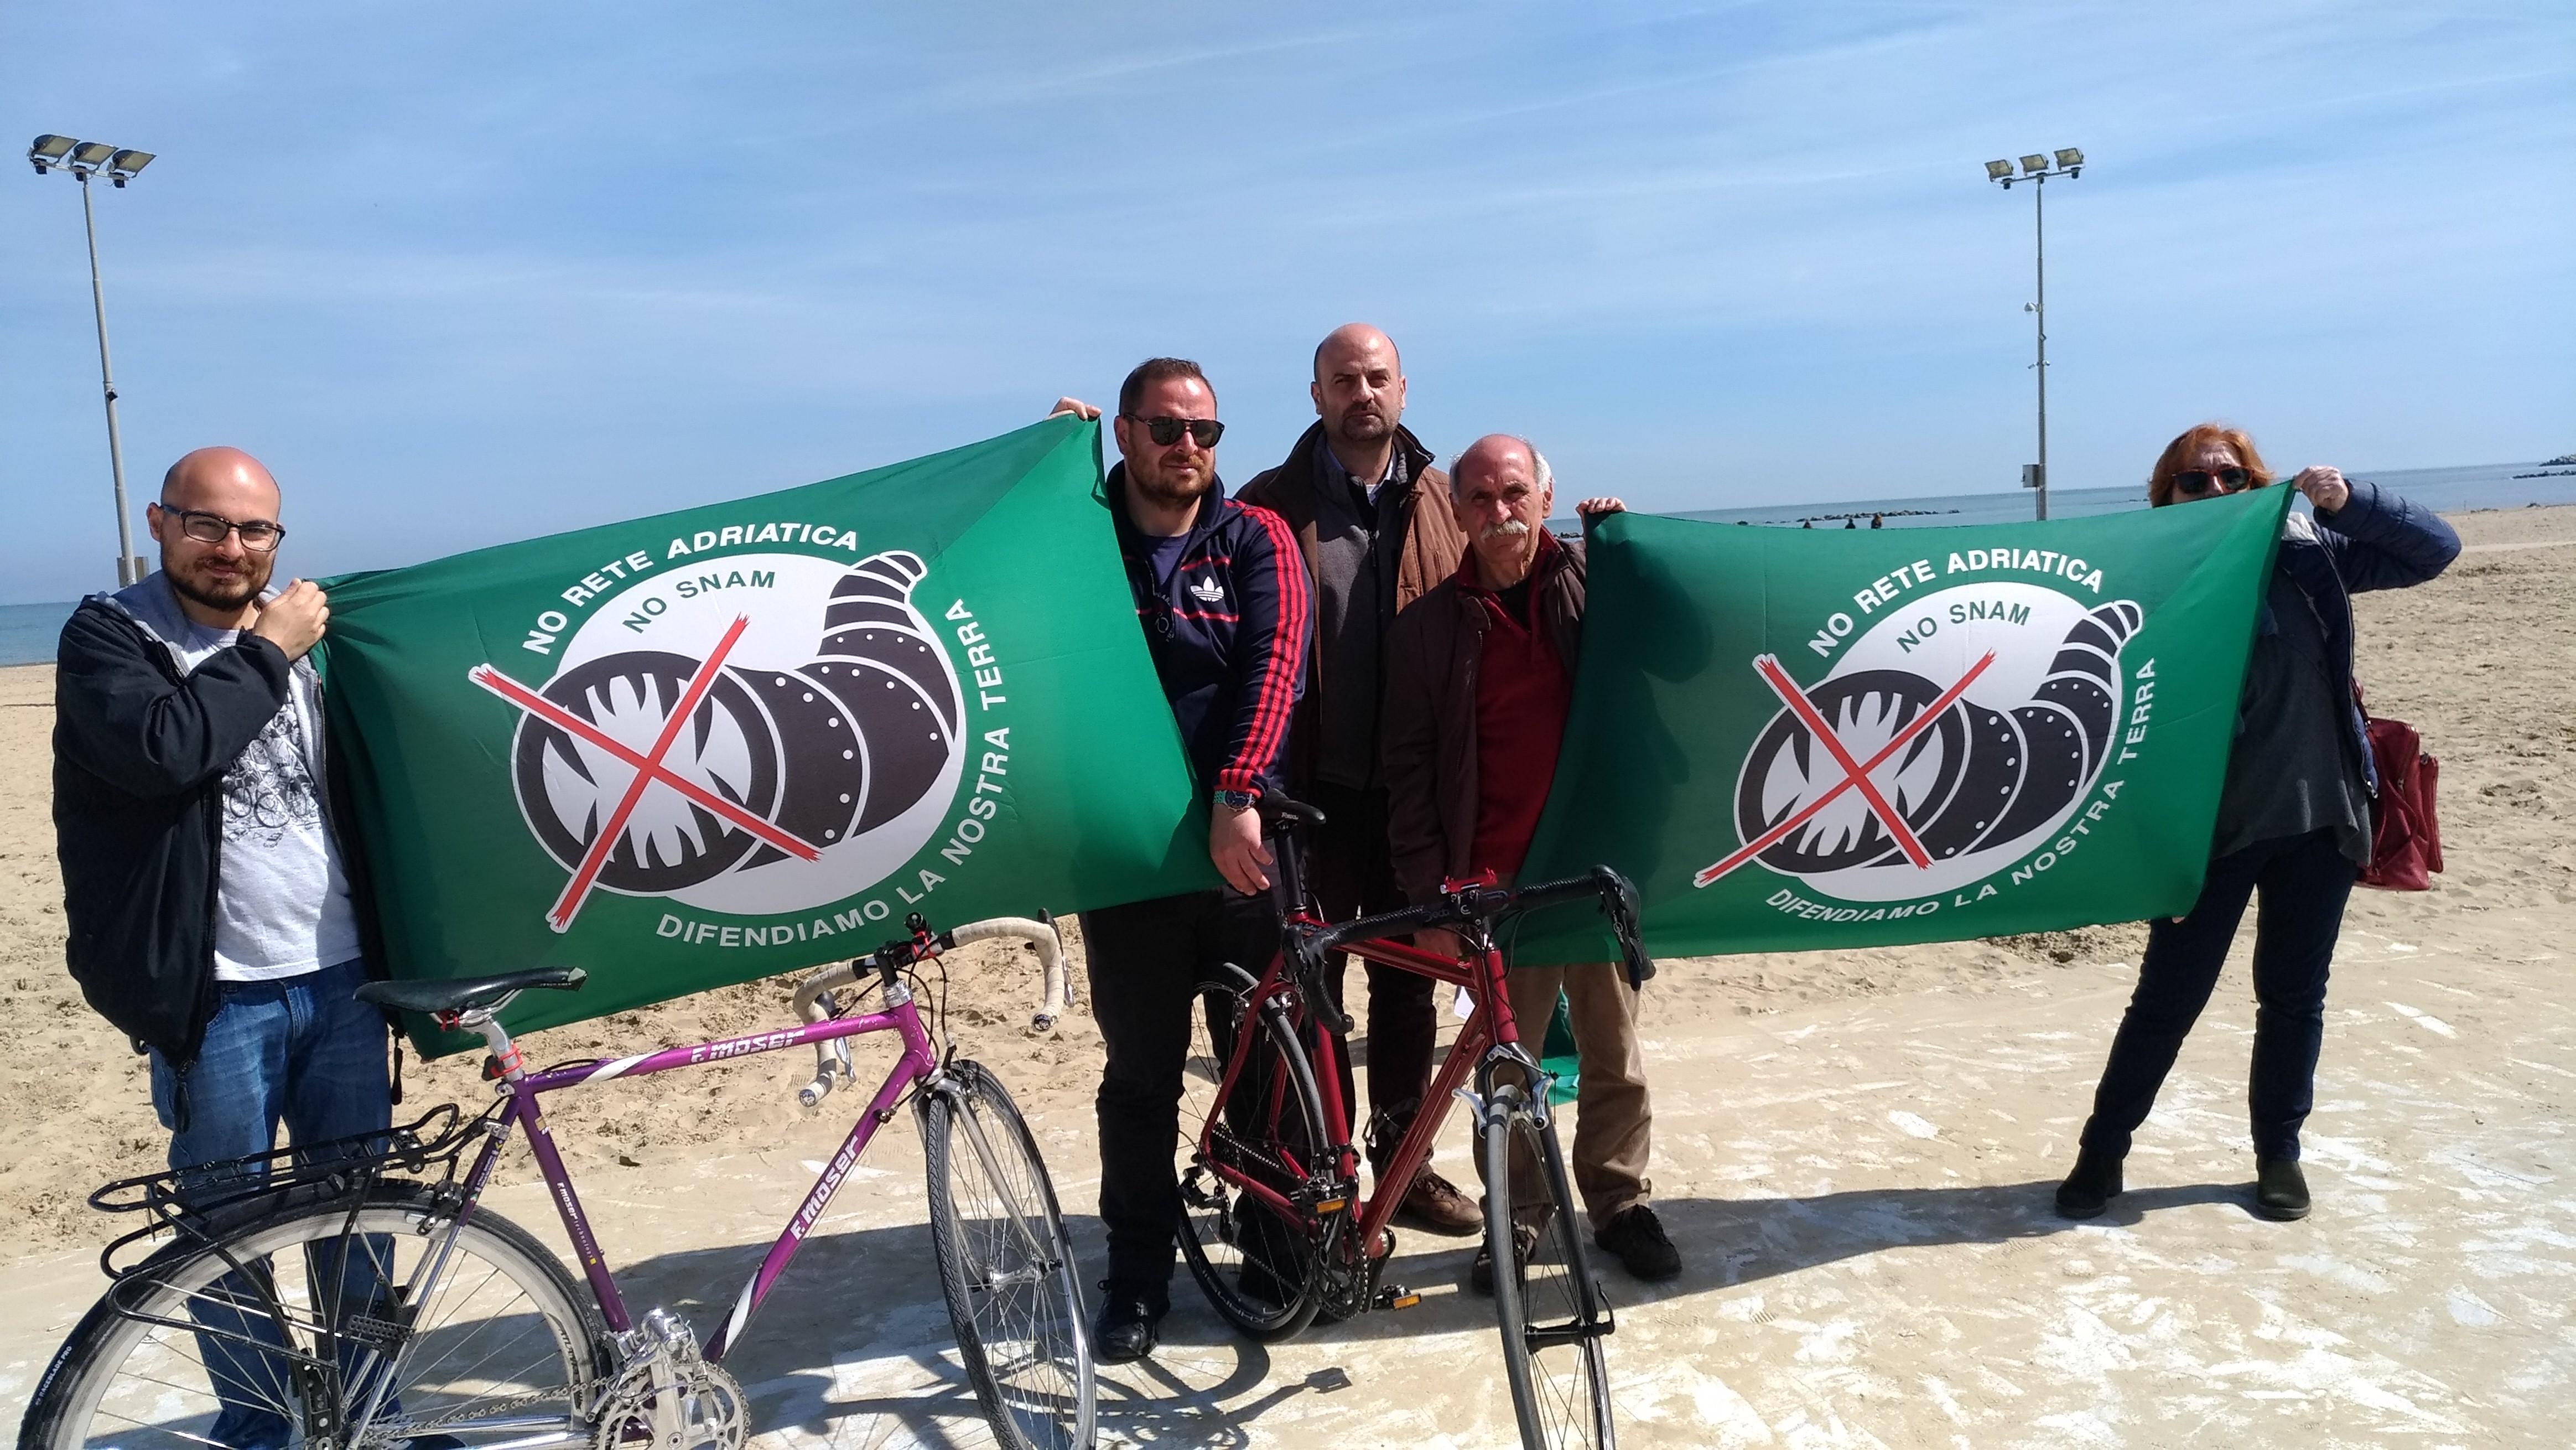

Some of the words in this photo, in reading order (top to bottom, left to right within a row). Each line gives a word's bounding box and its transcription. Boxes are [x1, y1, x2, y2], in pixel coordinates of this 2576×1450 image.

[522, 610, 568, 655] NO
[560, 550, 654, 607] RETE
[667, 522, 857, 560] ADRIATICA
[622, 597, 667, 634] NO
[676, 570, 775, 598] SNAM
[1808, 612, 1854, 658] NO
[1853, 559, 1936, 614] RETE
[1947, 548, 2104, 594] ADRIATICA
[1896, 617, 1937, 654] NO
[1949, 600, 2030, 626] SNAM
[944, 598, 1006, 711] TERRA
[941, 727, 1010, 866] NOSTRA
[1765, 889, 1940, 922] DIFENDIAMO
[1954, 884, 1998, 908] LA
[2011, 780, 2124, 885] NOSTRA
[2117, 657, 2156, 764] TERRA
[656, 900, 889, 946] DIFENDIAMO
[896, 869, 946, 905] LA
[39, 1359, 63, 1397] RACEBLADE
[60, 1345, 72, 1360] PRO
